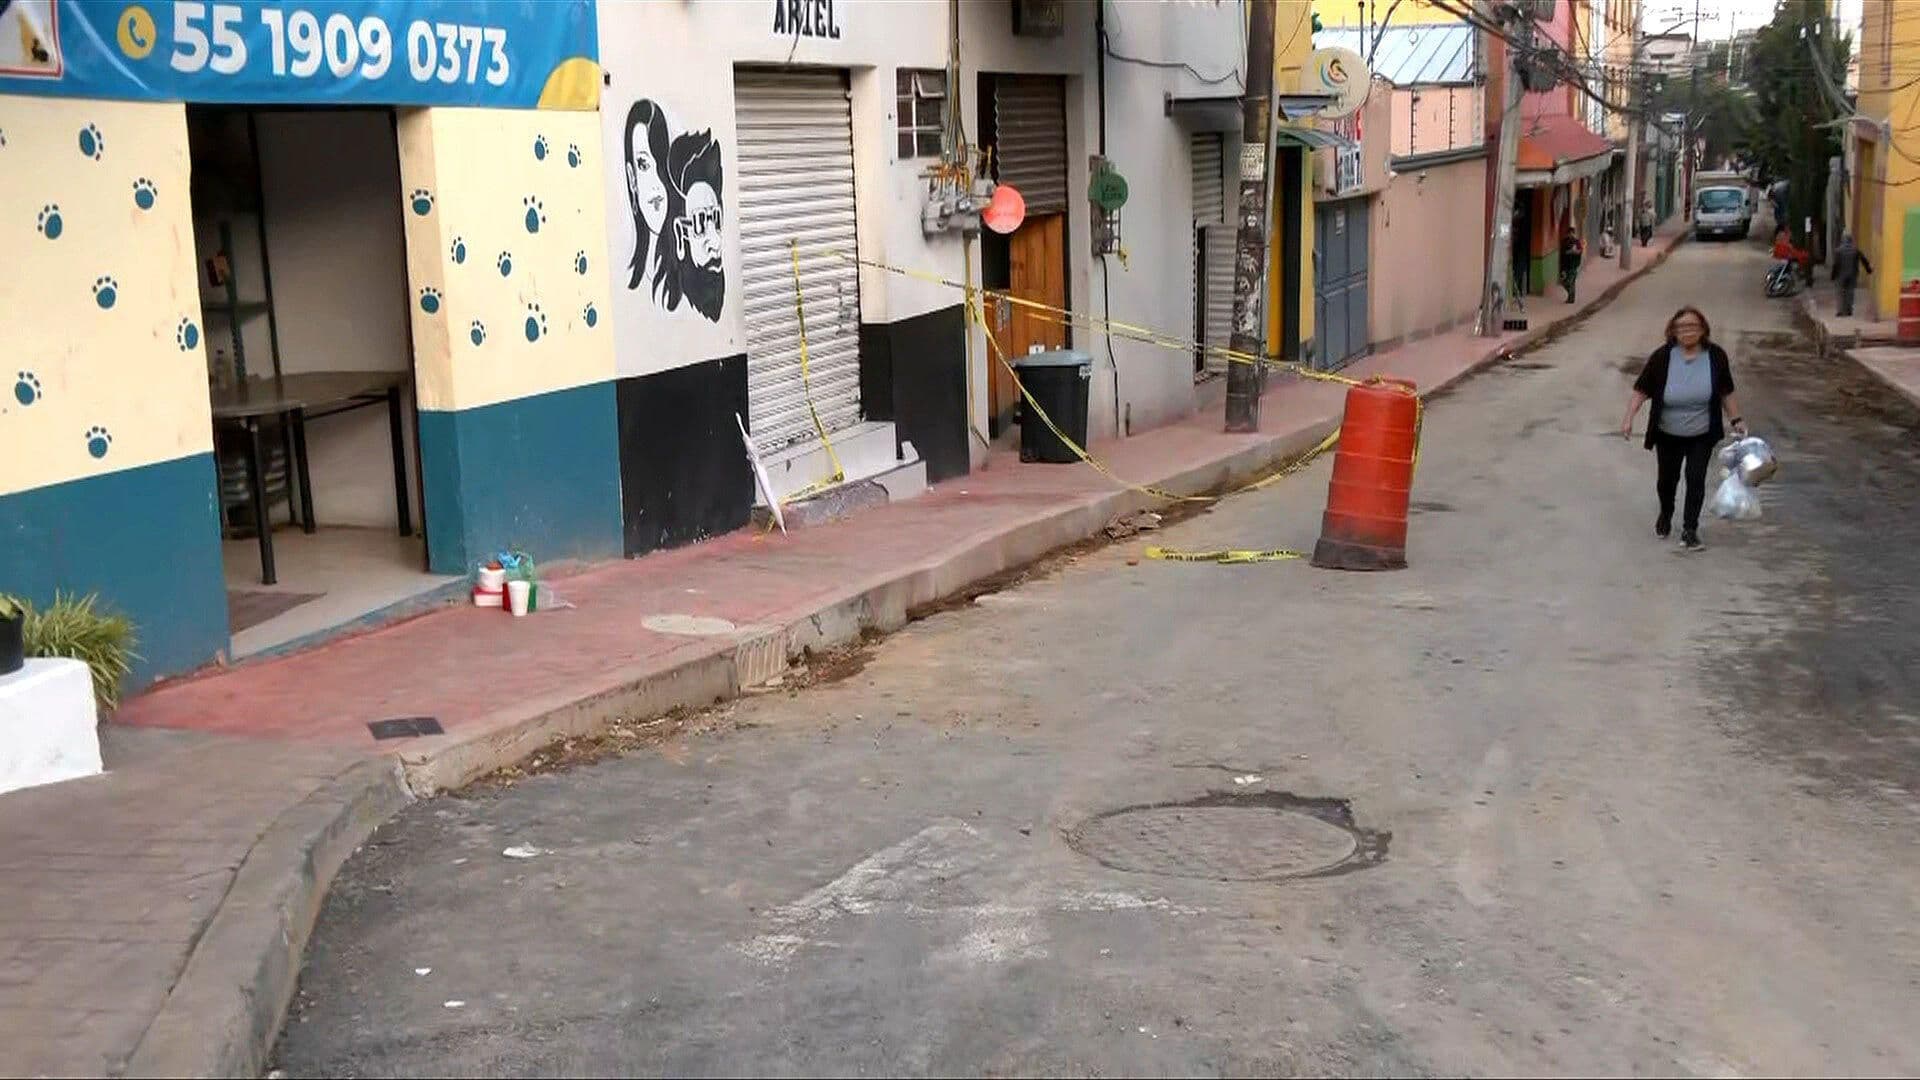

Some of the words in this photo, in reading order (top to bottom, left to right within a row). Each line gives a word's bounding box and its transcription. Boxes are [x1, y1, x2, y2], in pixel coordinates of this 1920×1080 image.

[170, 2, 248, 74] 55
[261, 9, 392, 80] 1909
[407, 21, 510, 86] 0373
[774, 0, 840, 39] ARIEL
